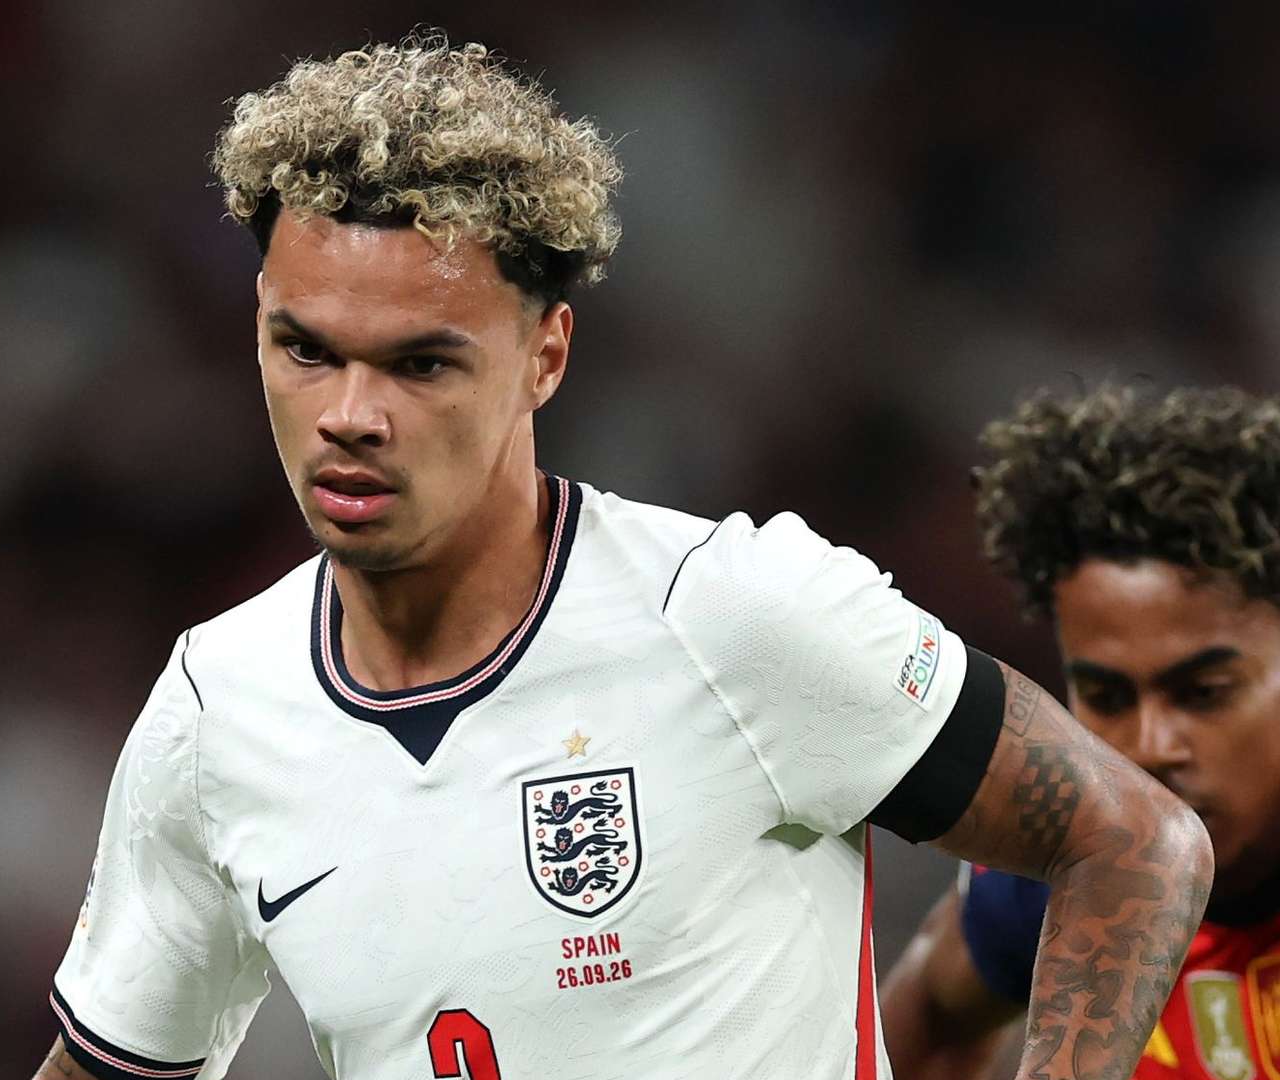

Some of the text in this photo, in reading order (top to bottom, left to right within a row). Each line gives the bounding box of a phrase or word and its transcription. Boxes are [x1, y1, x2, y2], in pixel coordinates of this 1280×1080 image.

[898, 654, 916, 688] UEFA
[906, 621, 936, 700] FOUN
[561, 932, 621, 960] SPAIN
[556, 959, 633, 990] 26.09.26
